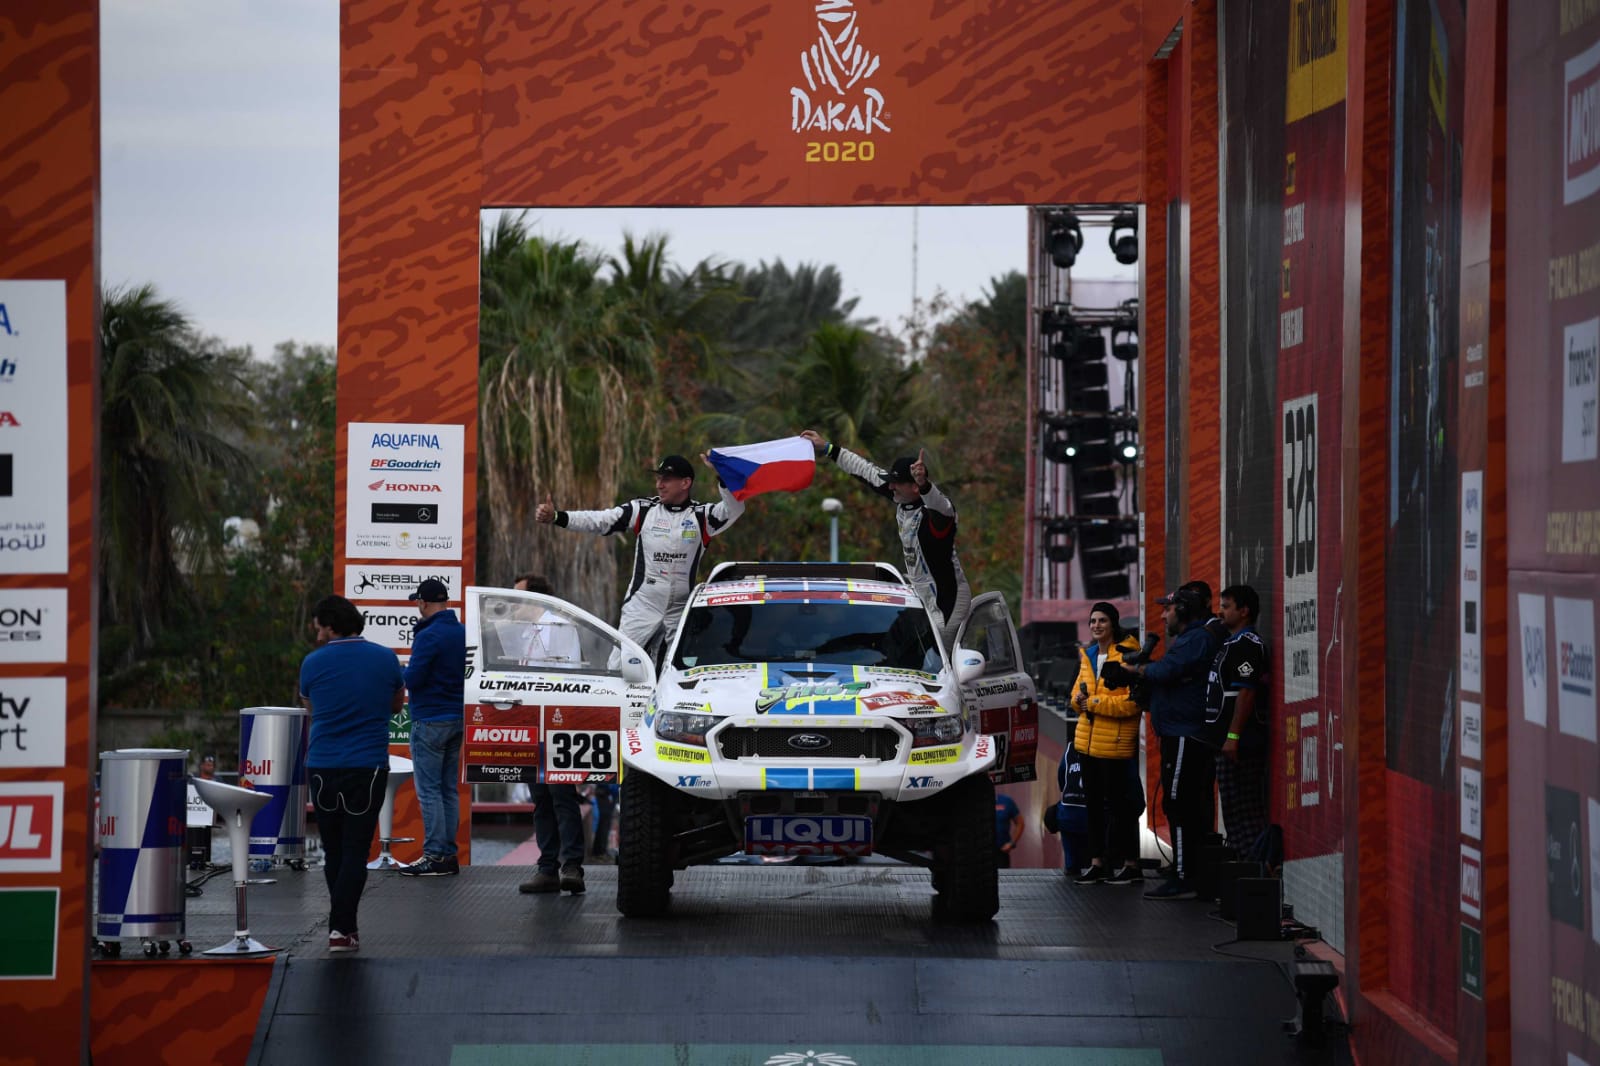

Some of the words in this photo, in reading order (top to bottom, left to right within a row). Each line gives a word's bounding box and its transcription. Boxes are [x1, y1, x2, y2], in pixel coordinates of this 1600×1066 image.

[790, 87, 891, 134] DAKAR
[805, 141, 875, 162] 2020
[371, 433, 440, 450] AQUAFINA
[370, 459, 441, 469] BFGoodrich
[385, 483, 441, 492] HONDA
[1285, 403, 1315, 578] 328
[355, 539, 391, 547] CATERING
[711, 595, 751, 604] MOTUL
[473, 728, 531, 743] MOTUL
[552, 733, 612, 769] 328
[658, 746, 705, 761] GOLDNUTRITION
[911, 748, 958, 761] GOLDNUTRITION
[499, 773, 522, 783] sport
[549, 773, 583, 782] MOTUL
[752, 818, 865, 843] LIQUI
